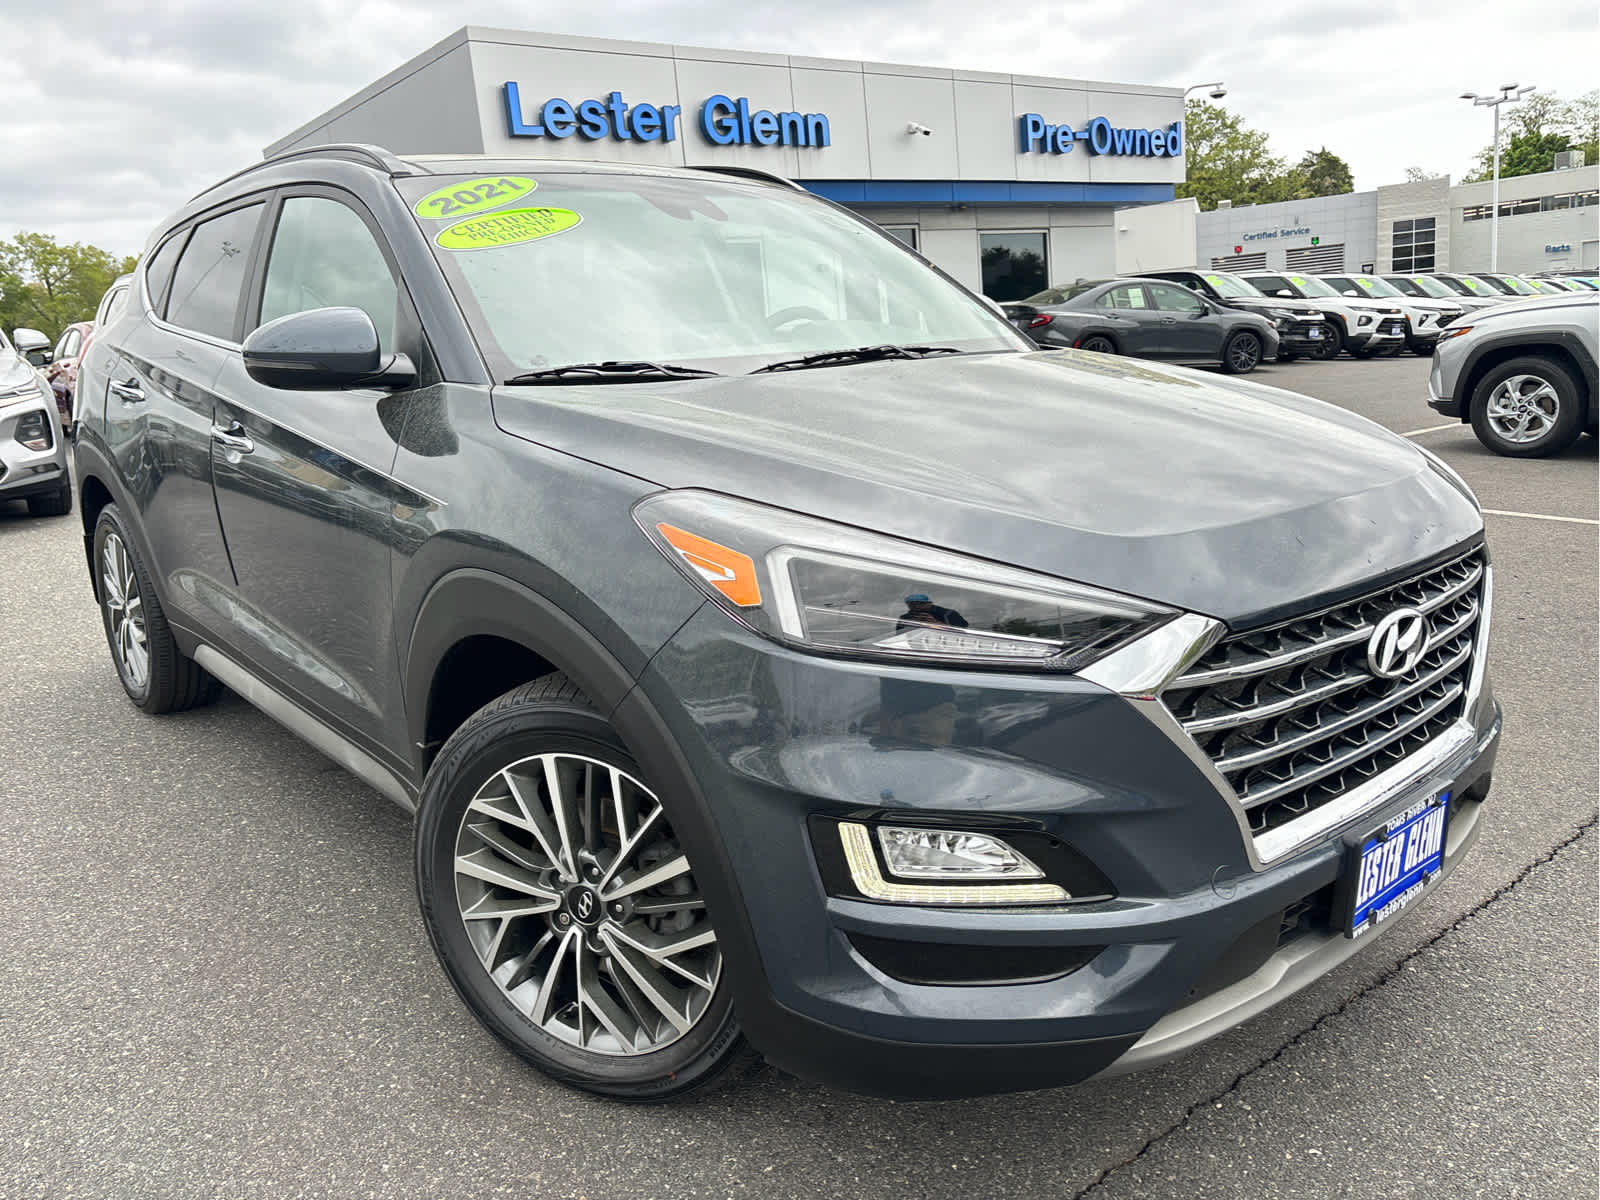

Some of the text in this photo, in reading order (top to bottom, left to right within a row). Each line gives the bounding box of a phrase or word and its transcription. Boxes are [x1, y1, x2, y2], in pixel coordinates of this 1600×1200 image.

[501, 81, 831, 148] Lester Glenn
[1020, 113, 1182, 157] Pre-Owned
[429, 178, 525, 215] 2021
[451, 208, 553, 236] CERTIFIED
[487, 224, 553, 243] VEHICLE
[1243, 227, 1310, 241] Certified Service
[1356, 805, 1446, 909] LESTER GLENN
